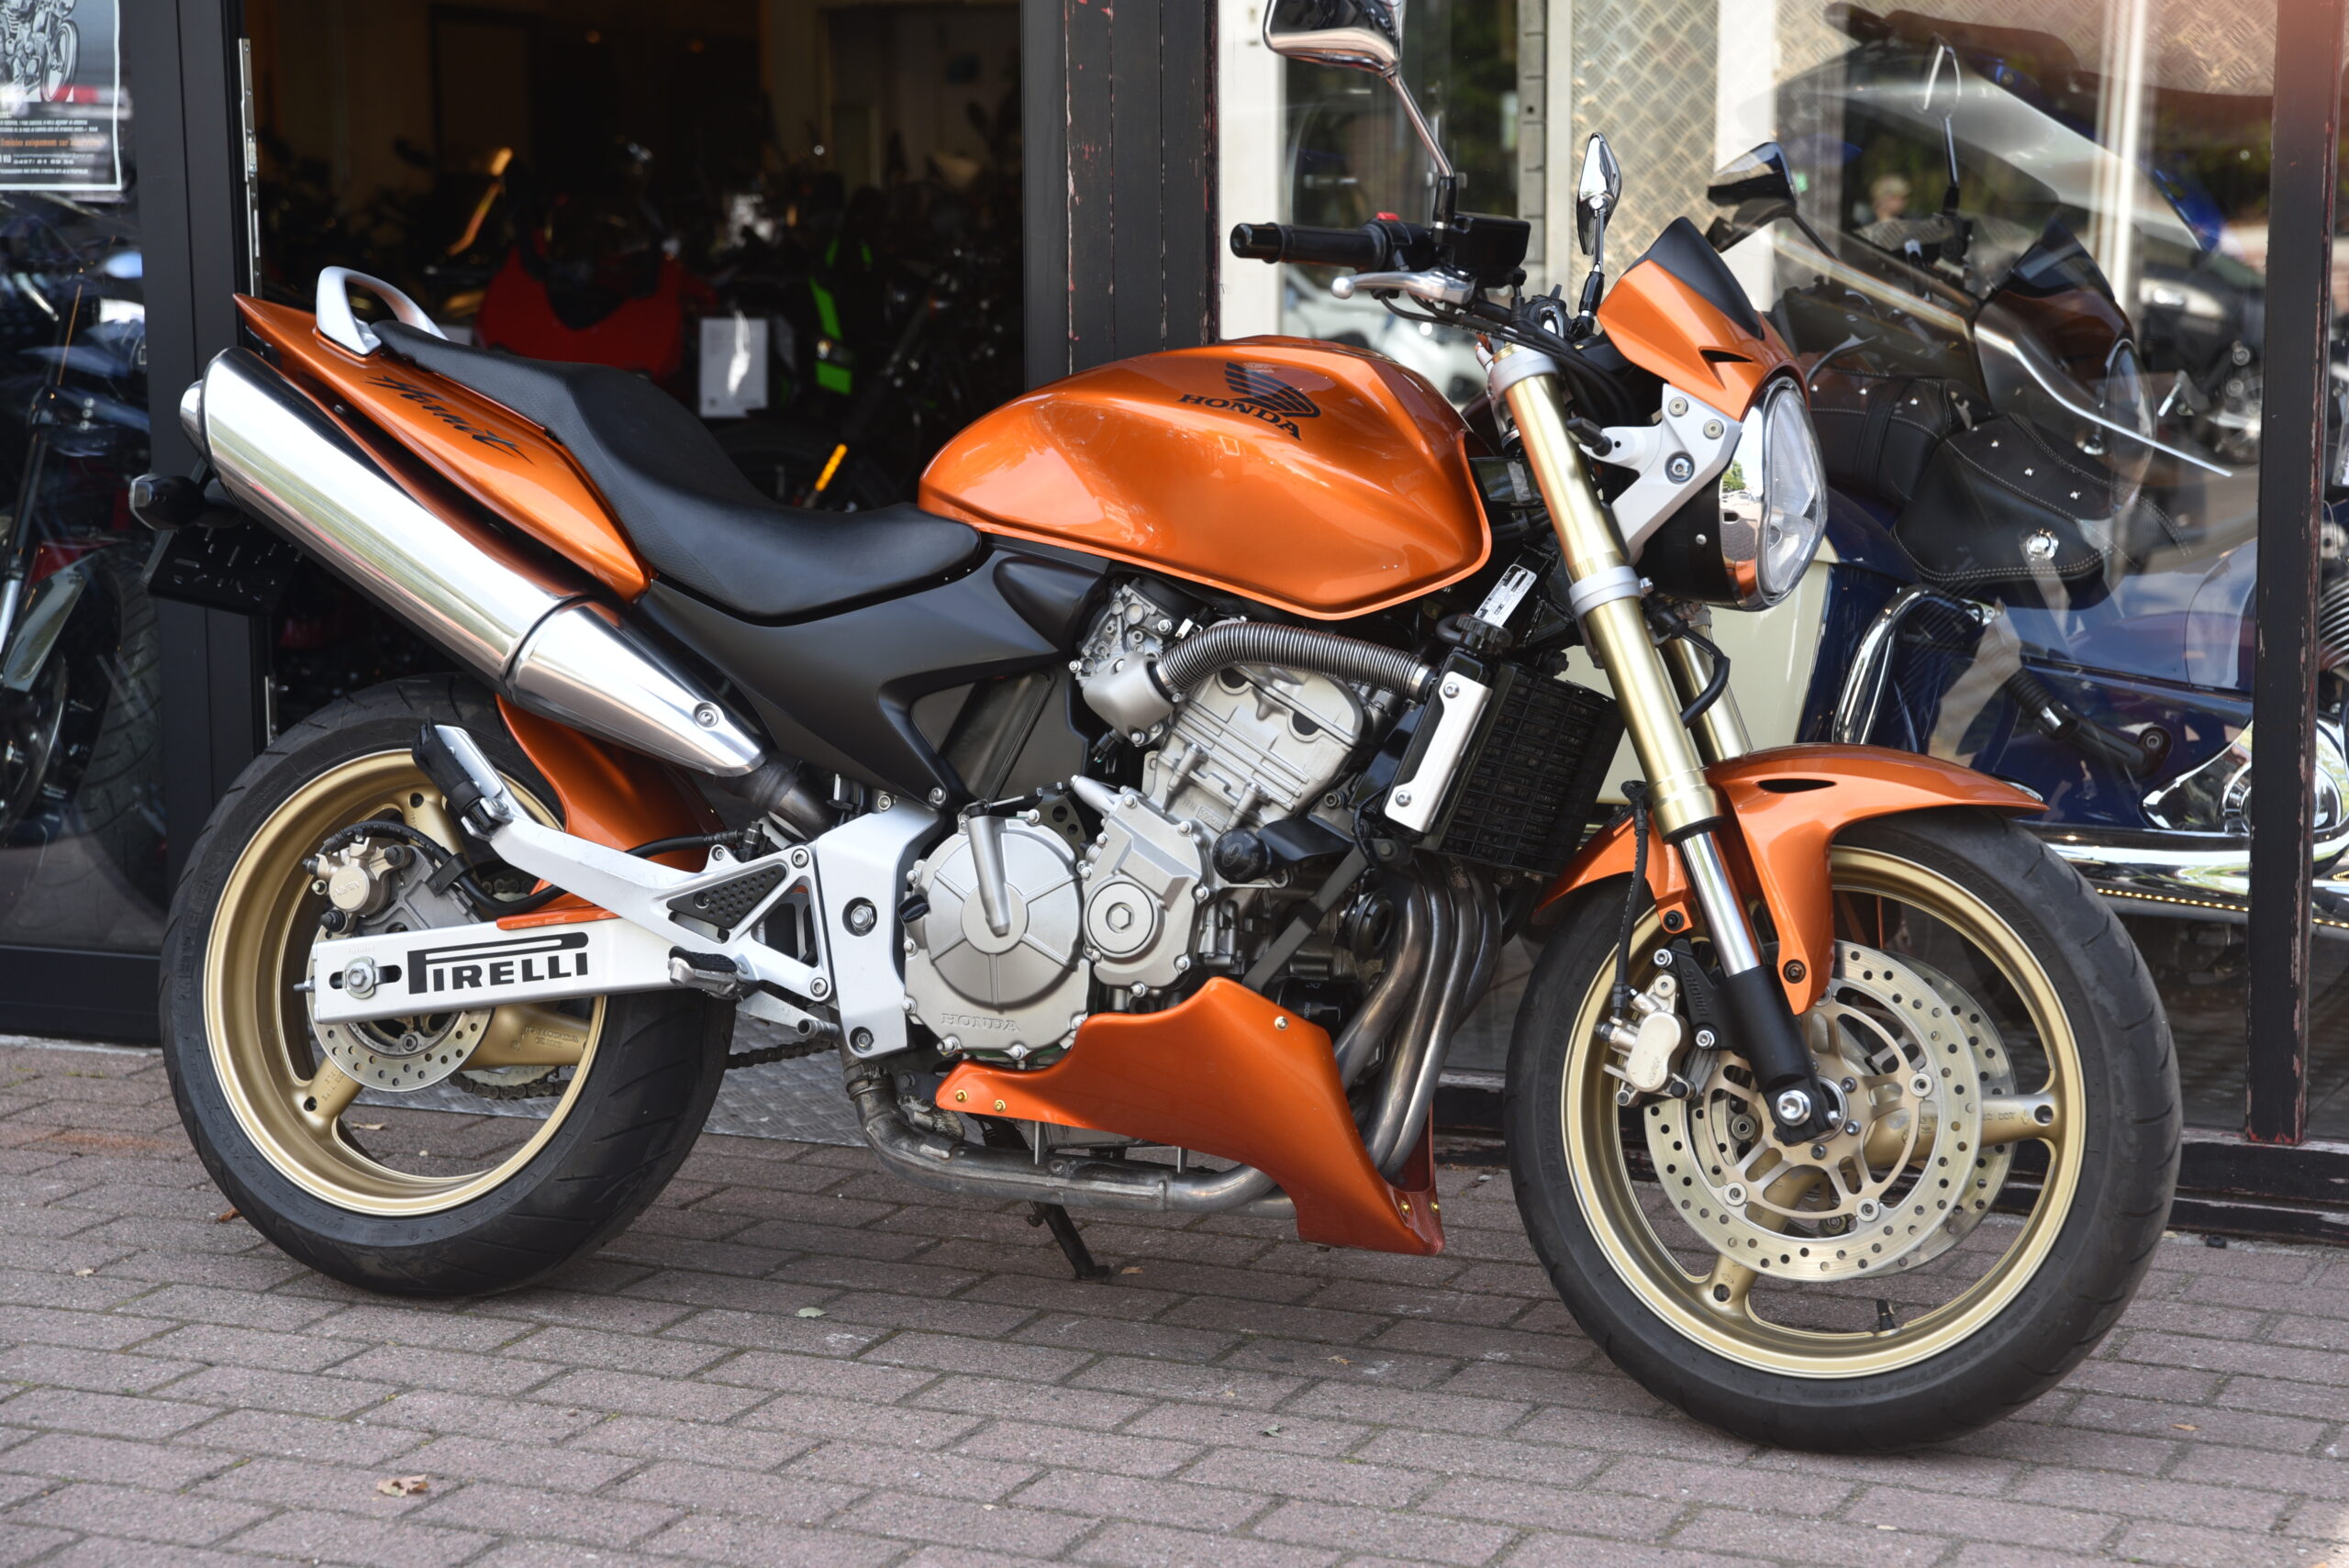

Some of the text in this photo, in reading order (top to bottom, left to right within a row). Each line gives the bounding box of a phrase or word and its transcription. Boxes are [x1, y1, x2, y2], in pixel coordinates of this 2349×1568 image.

[1176, 394, 1302, 441] HONDA
[407, 931, 589, 995] PIRELLI
[941, 1012, 1021, 1032] HONDA
